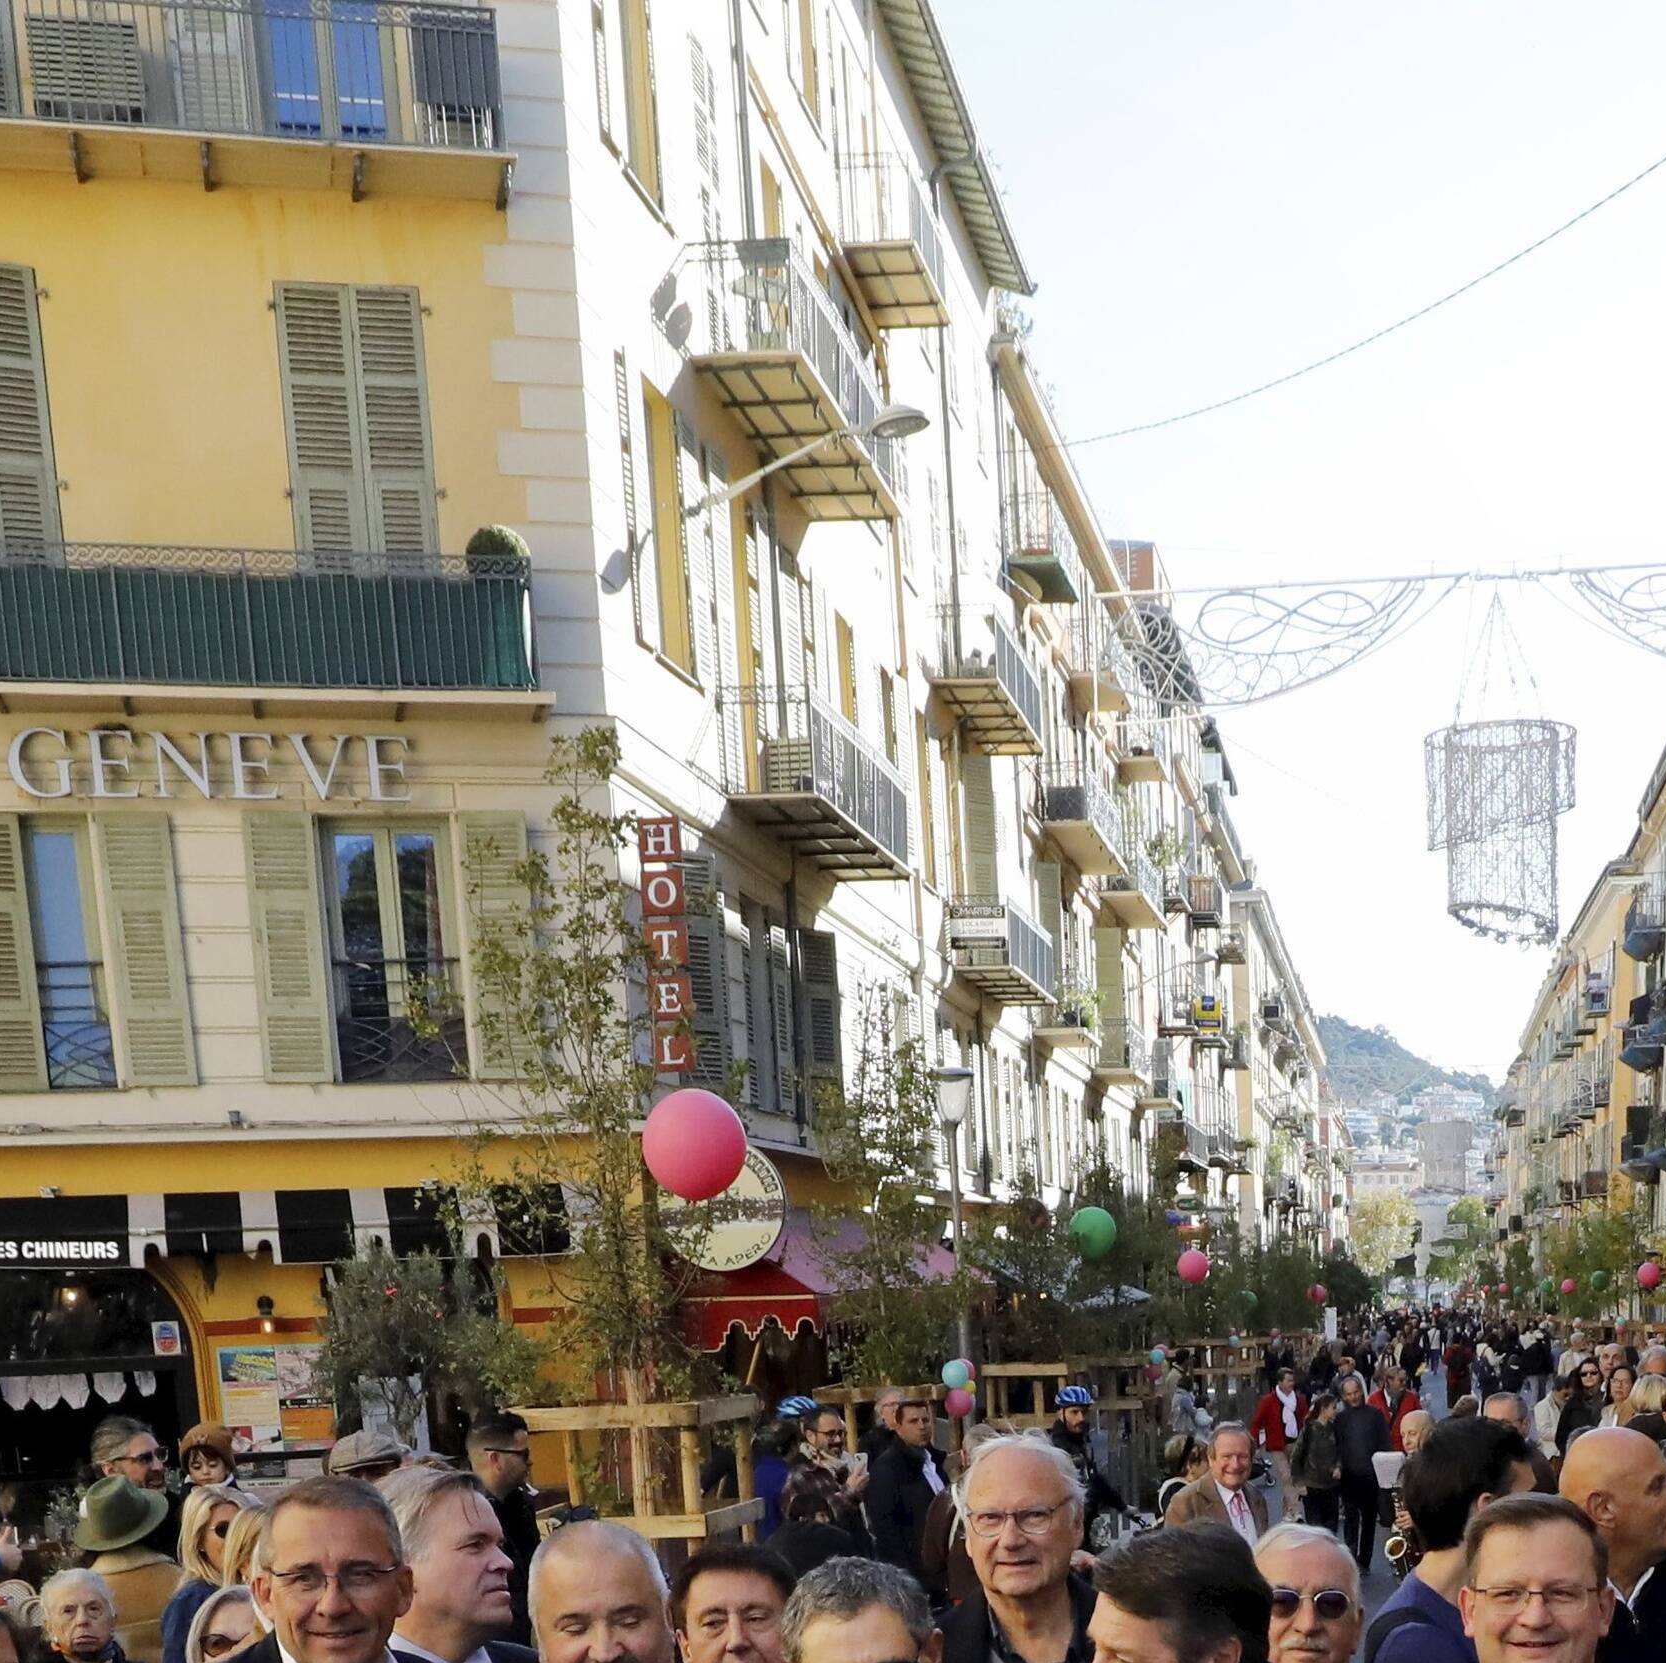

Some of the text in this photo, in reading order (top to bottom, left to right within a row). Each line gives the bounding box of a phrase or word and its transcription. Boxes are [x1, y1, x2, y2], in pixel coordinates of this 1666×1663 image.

[7, 727, 413, 801] GENEVE
[642, 823, 686, 1066] HOTEL
[21, 1241, 120, 1260] CHINEURS
